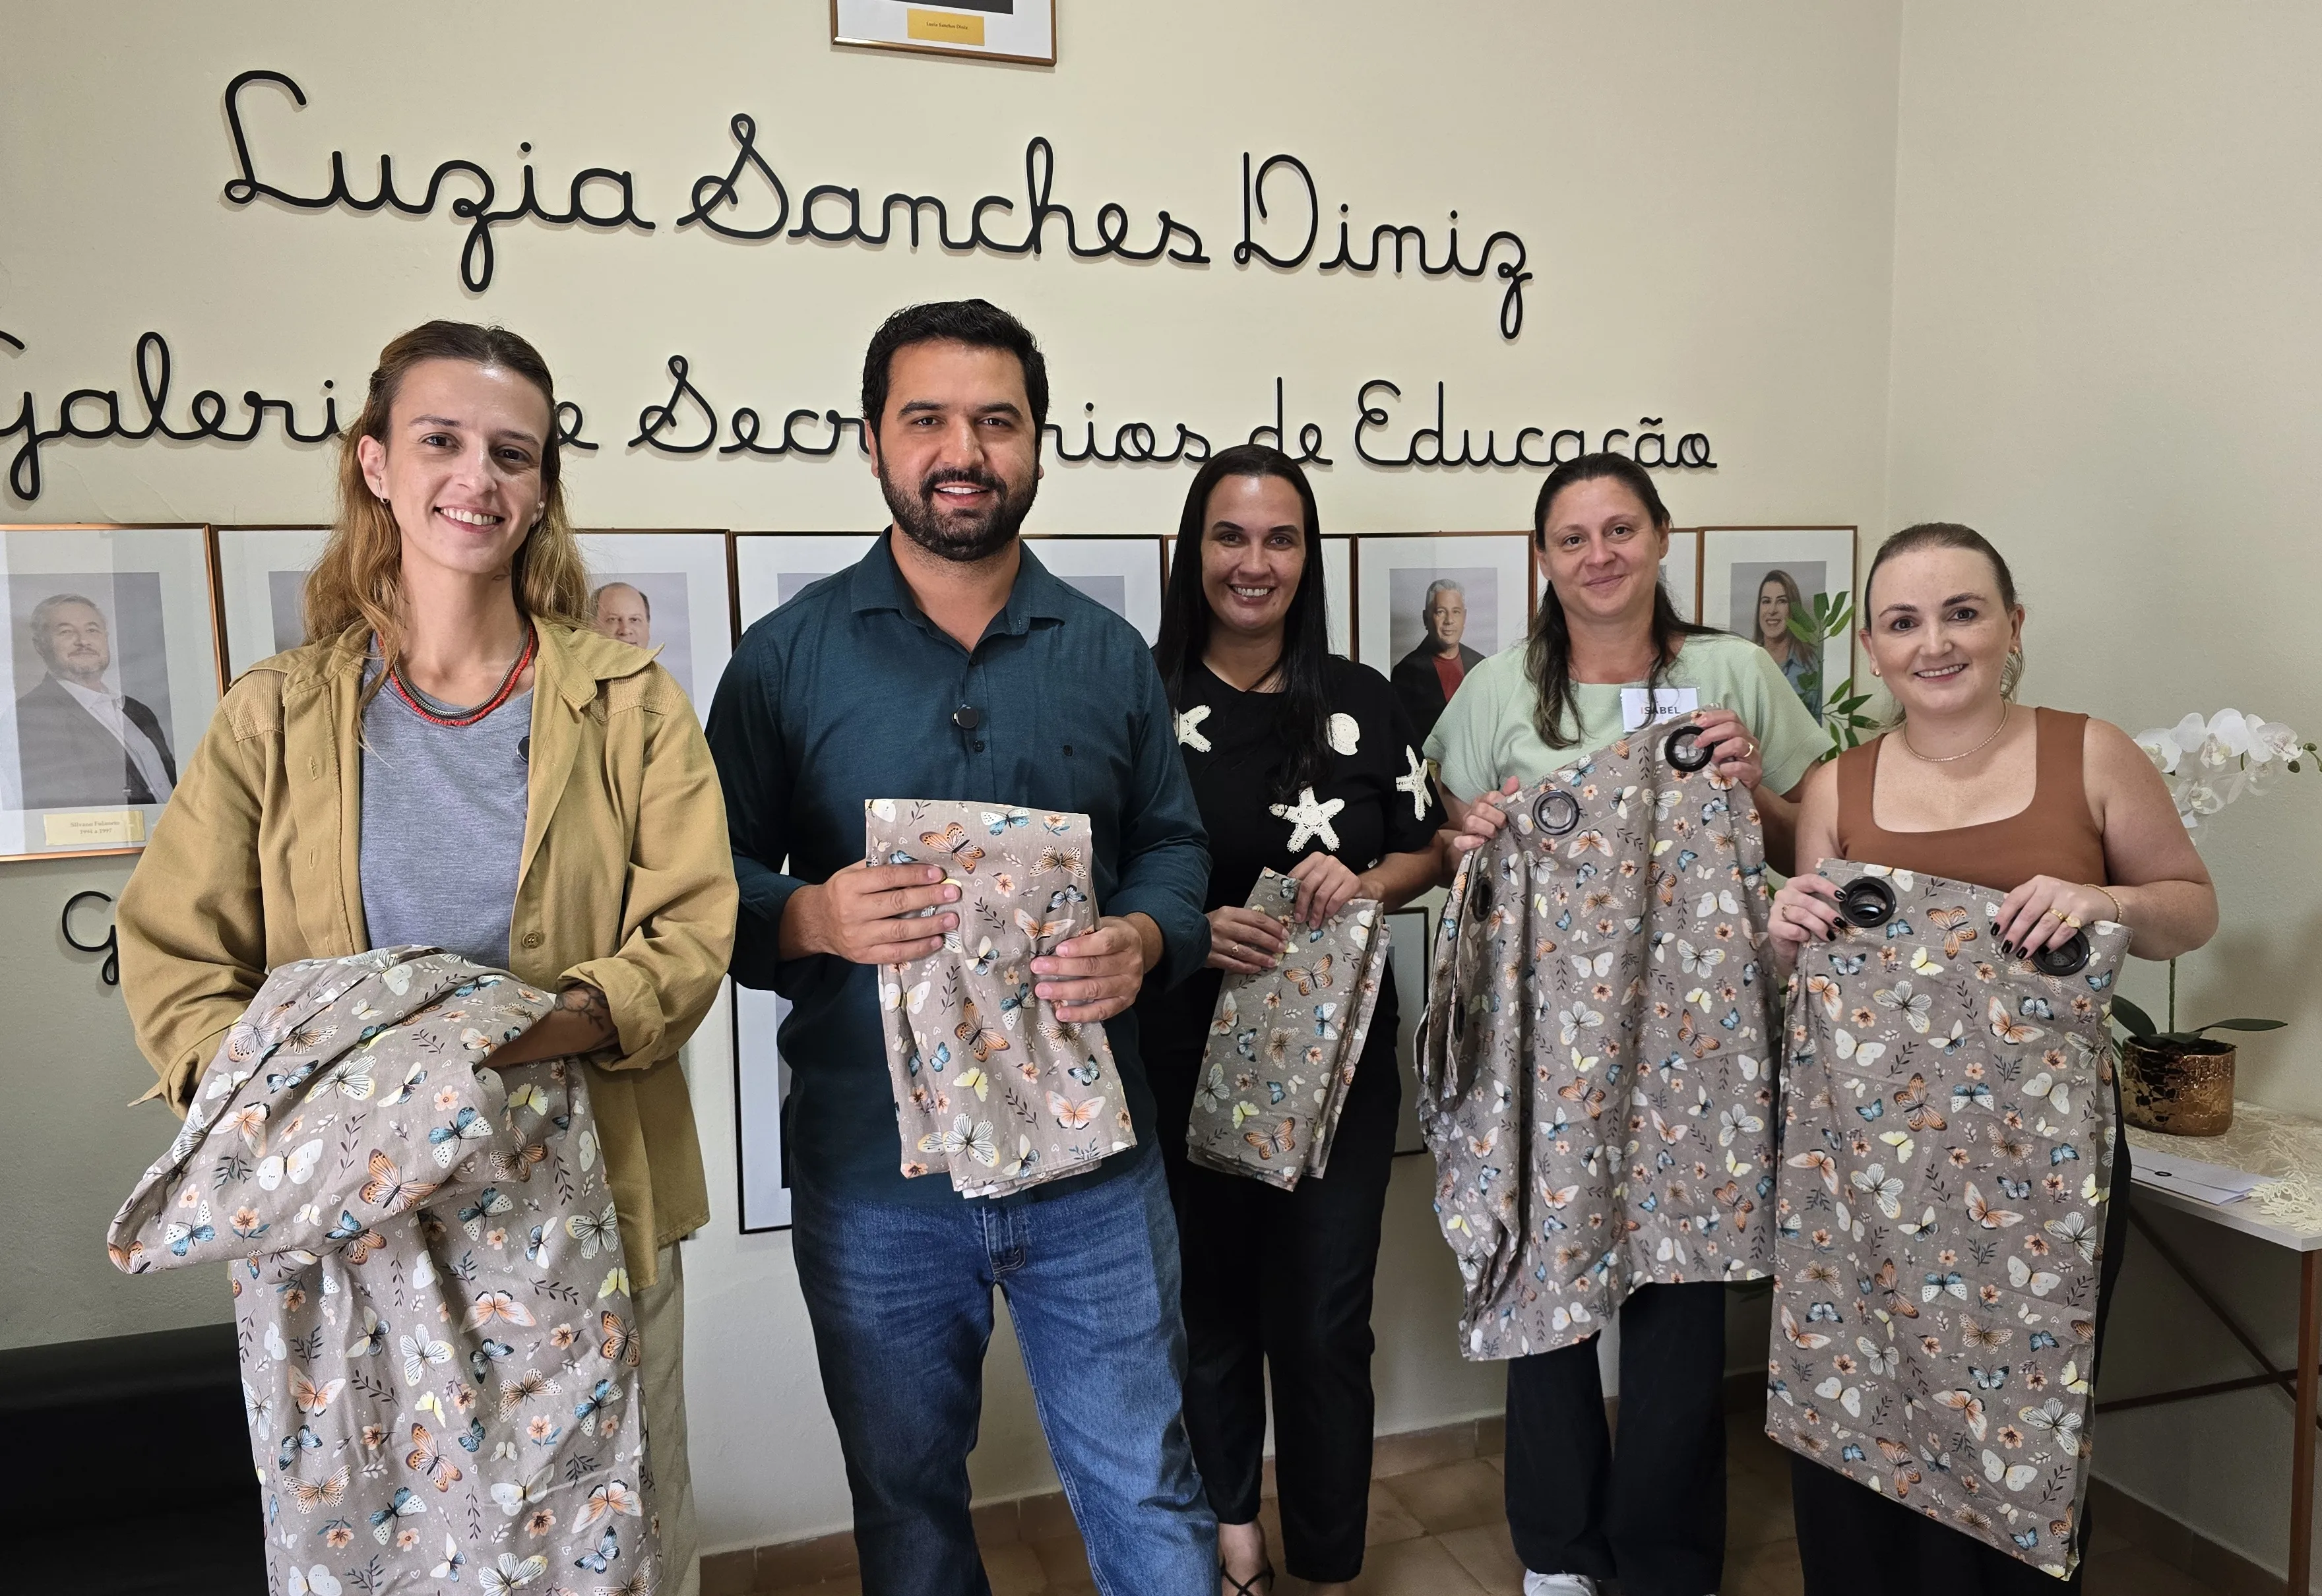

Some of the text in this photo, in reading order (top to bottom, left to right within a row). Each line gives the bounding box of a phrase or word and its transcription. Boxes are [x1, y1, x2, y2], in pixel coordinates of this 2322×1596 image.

[224, 70, 1534, 340] Luzia Sanches Diniz
[0, 330, 342, 501] aleri
[556, 401, 599, 450] e
[627, 355, 1211, 462] Secrios
[1248, 377, 1333, 466] de
